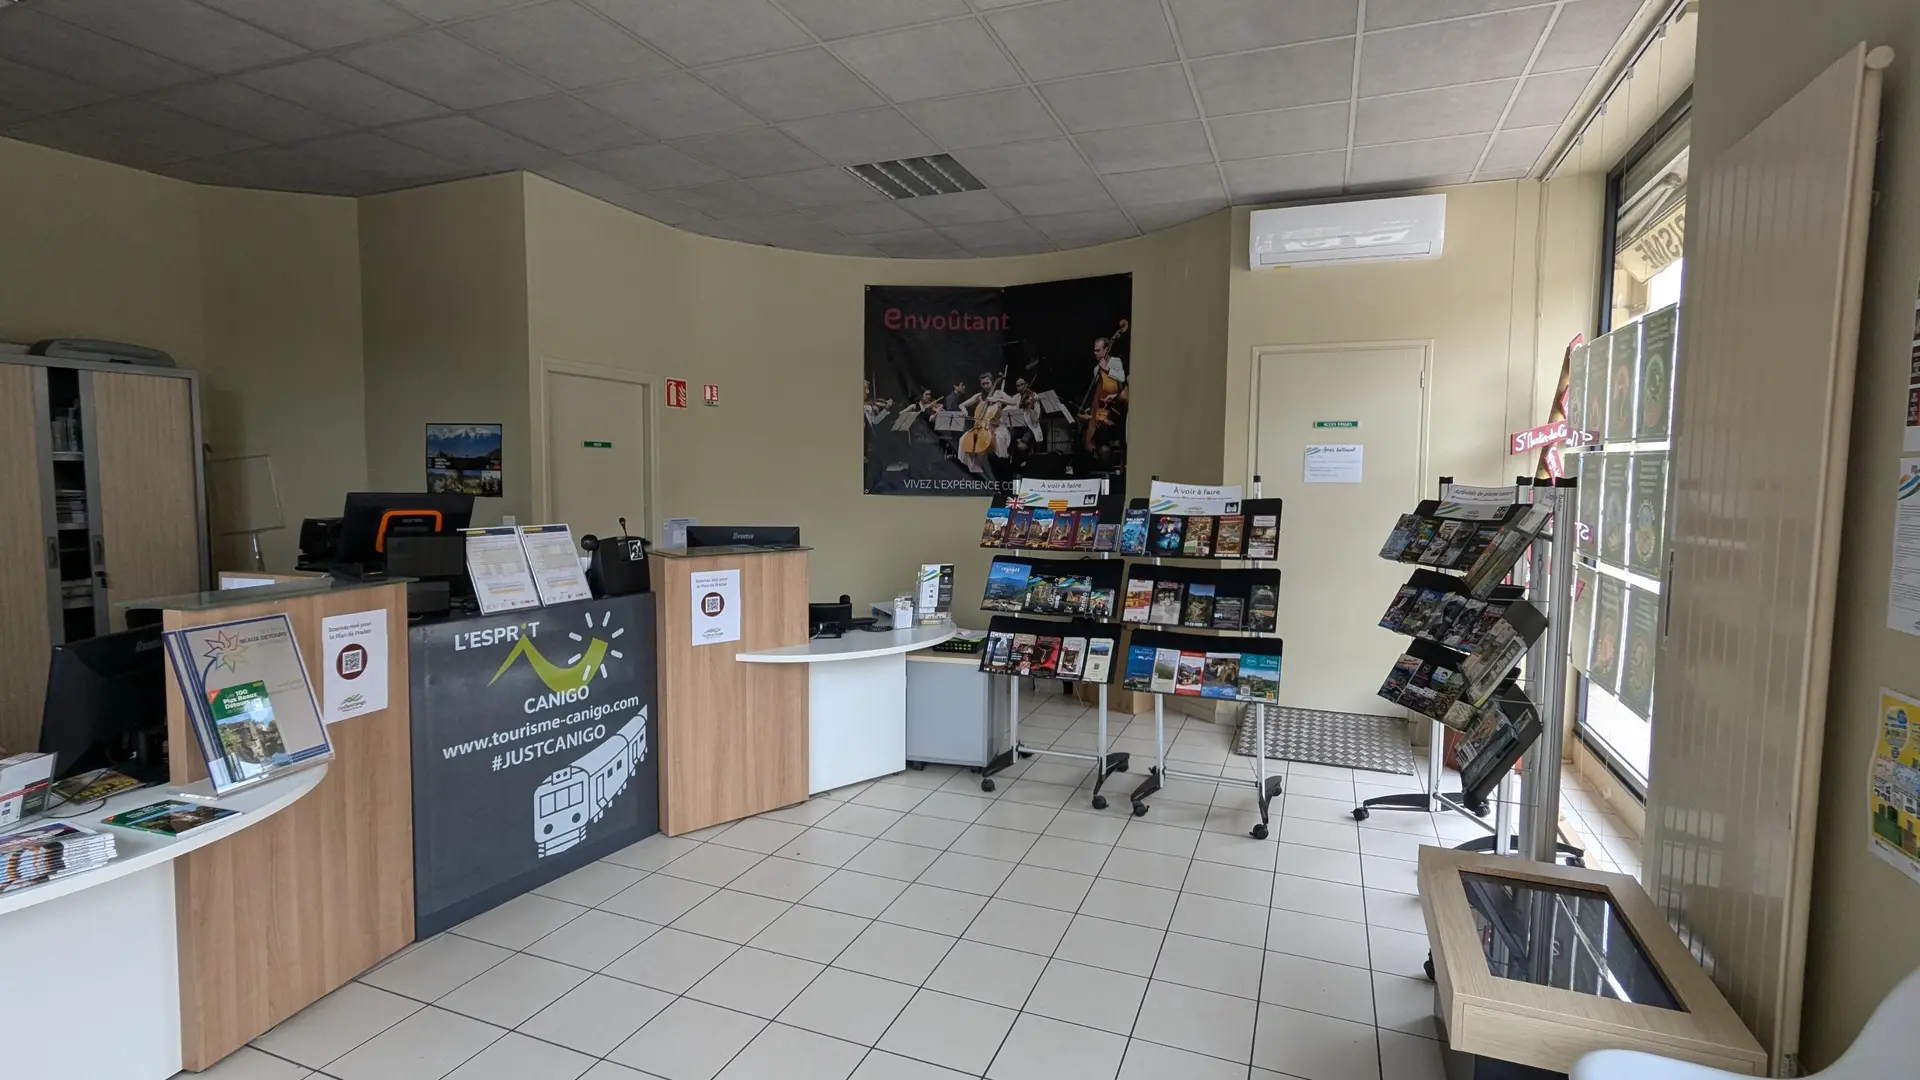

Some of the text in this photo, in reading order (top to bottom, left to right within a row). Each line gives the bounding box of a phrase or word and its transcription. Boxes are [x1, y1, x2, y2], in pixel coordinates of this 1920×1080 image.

[884, 308, 1010, 331] envoûtant
[903, 479, 932, 489] VIVEZ
[933, 478, 1000, 491] L'EXPÉRIENCE
[1173, 486, 1179, 495] À
[1197, 487, 1202, 495] à
[1203, 488, 1221, 496] faire
[222, 692, 257, 705] Plus Beaux
[524, 685, 589, 714] CANIGO
[442, 696, 639, 759] www.tourisme-canigo.com
[491, 724, 606, 772] #JUSTCANIGO
